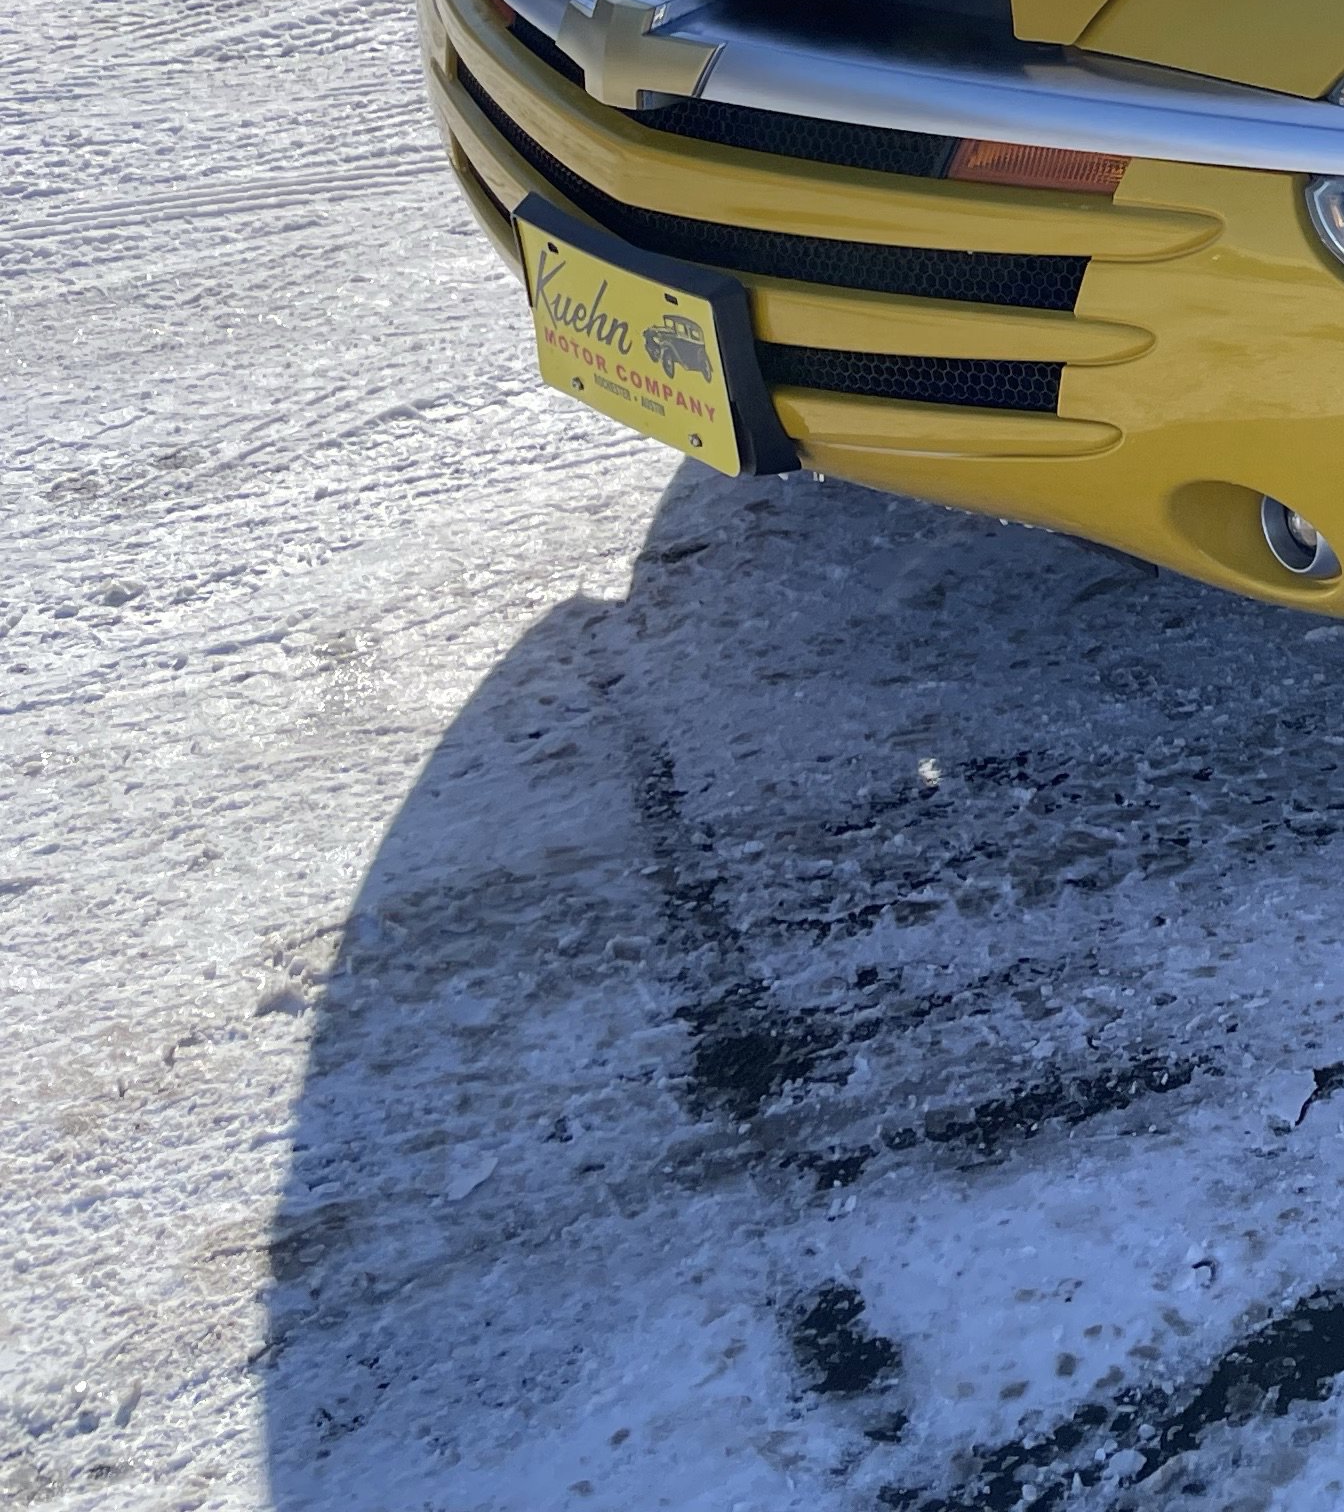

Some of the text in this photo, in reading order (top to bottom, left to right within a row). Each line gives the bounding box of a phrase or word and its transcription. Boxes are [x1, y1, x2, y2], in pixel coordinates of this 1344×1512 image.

[534, 250, 632, 355] Kuehn
[544, 327, 717, 424] MOTOR COMPANY
